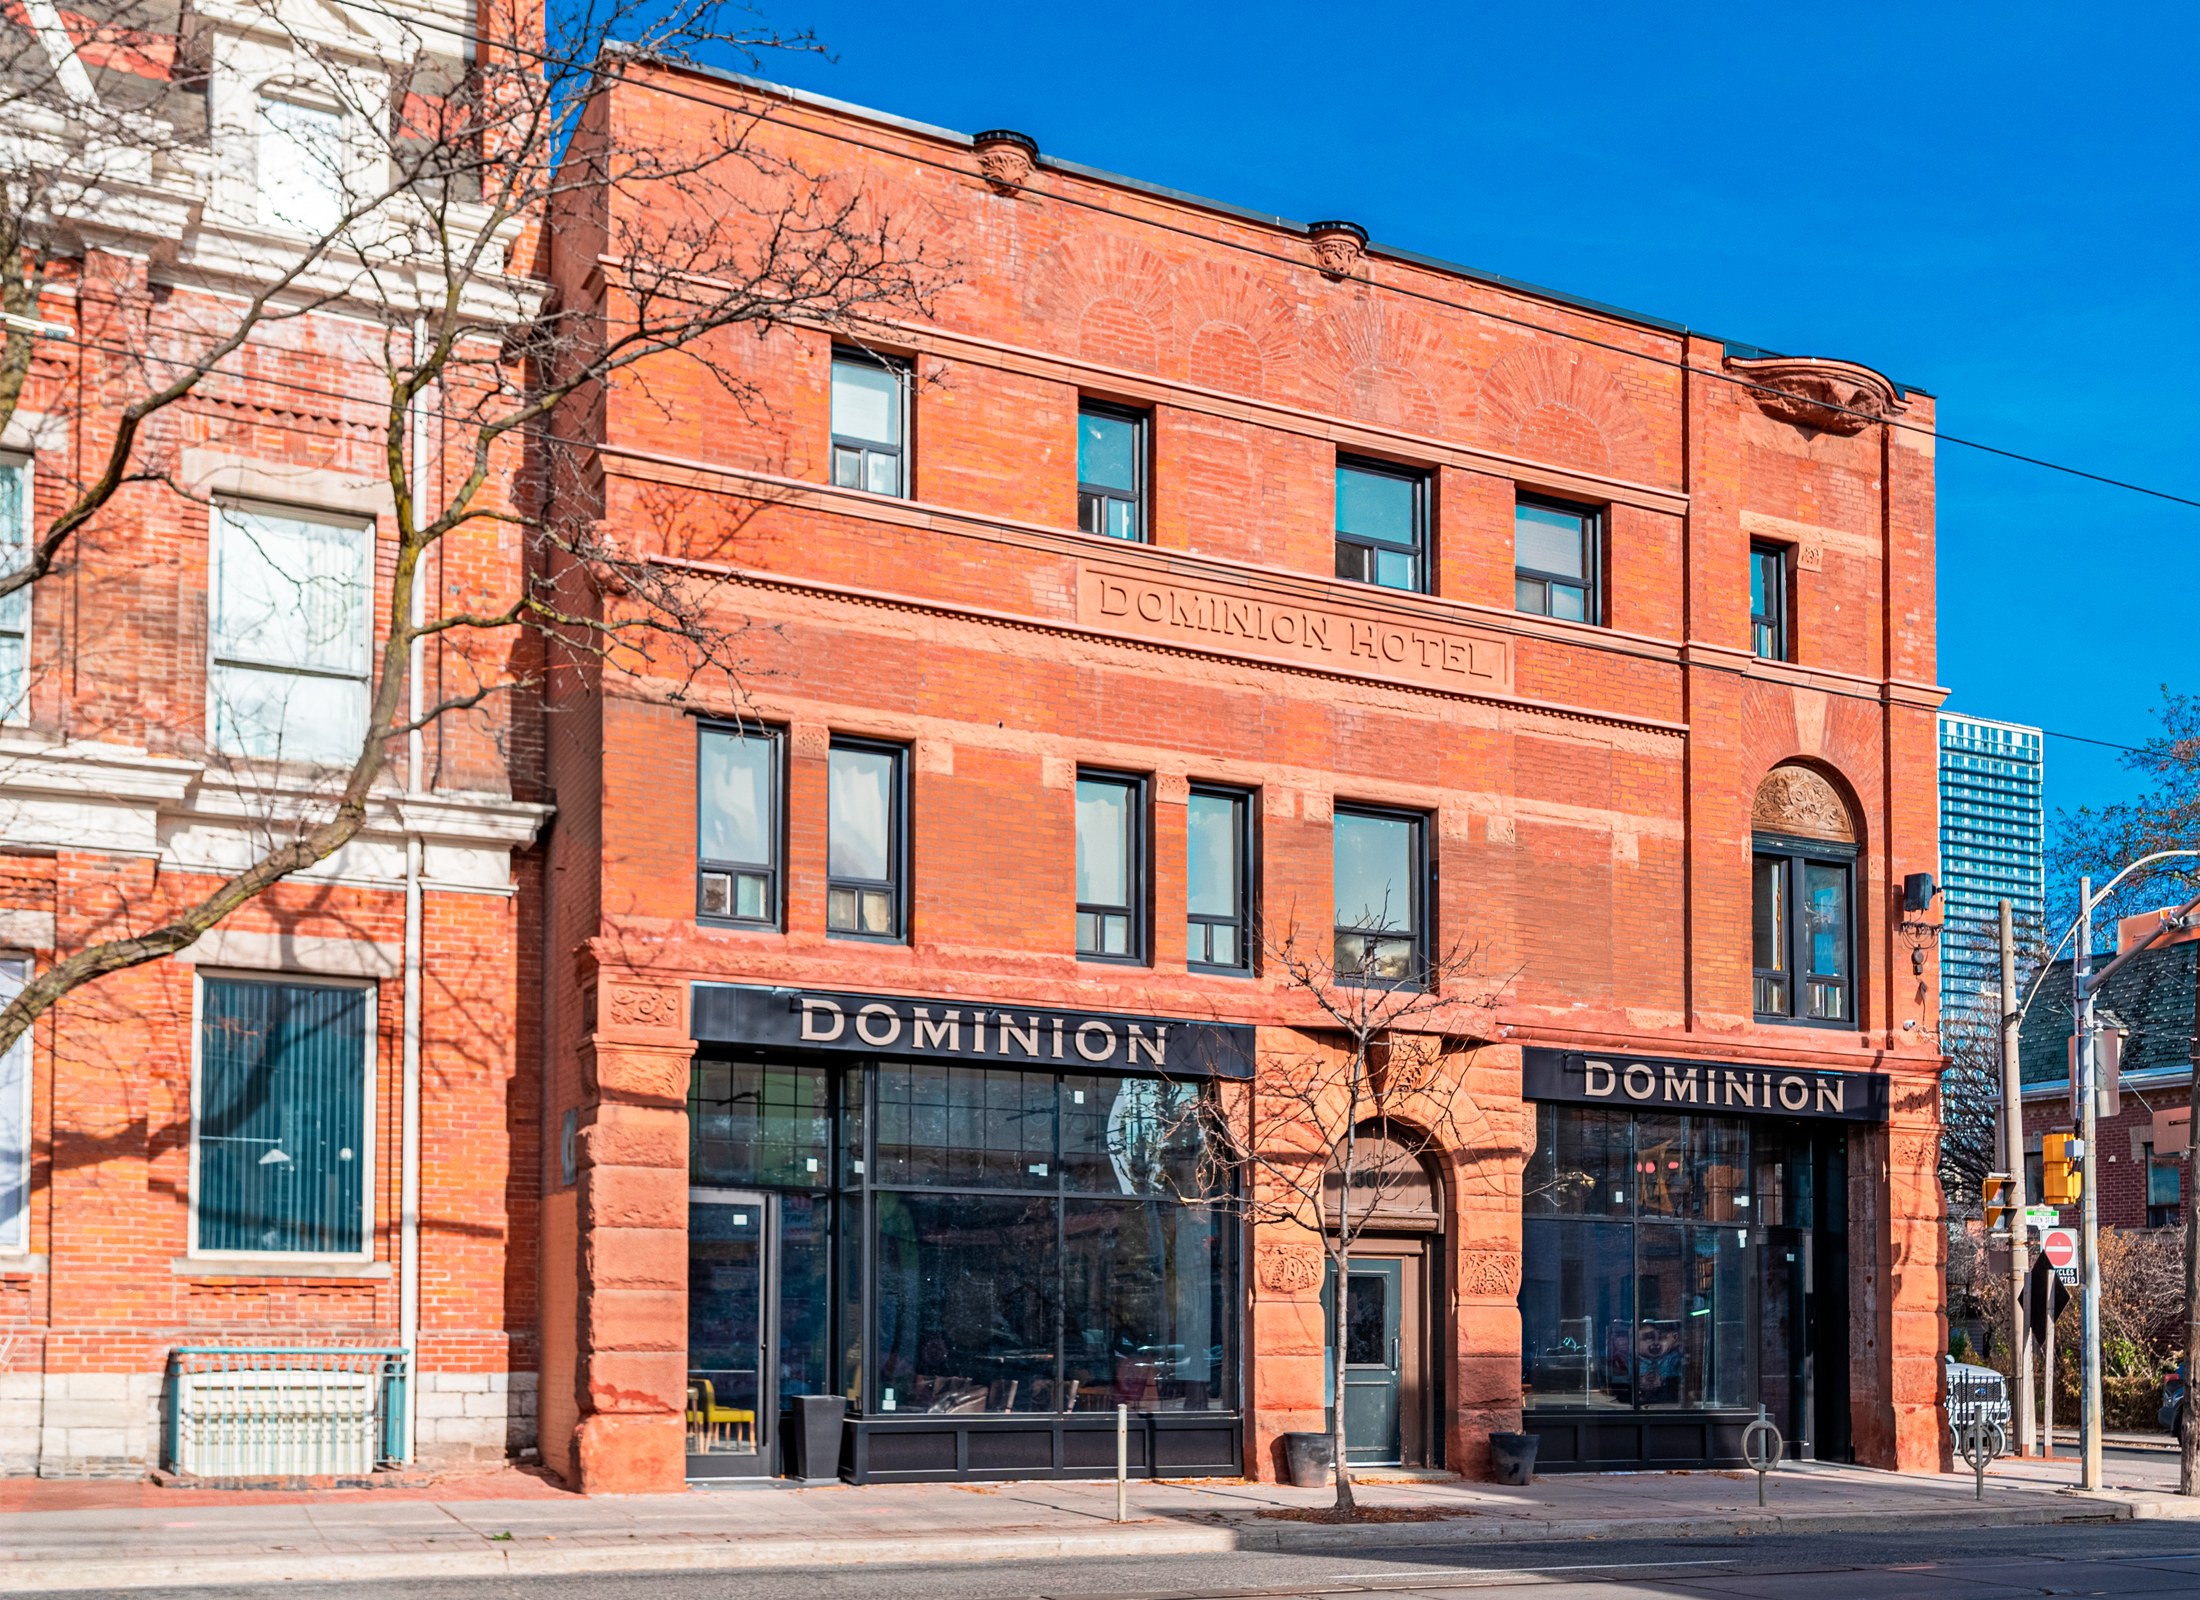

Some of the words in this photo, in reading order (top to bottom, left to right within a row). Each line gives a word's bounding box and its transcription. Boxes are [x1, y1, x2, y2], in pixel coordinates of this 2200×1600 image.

[1100, 579, 1332, 651] DOMINION
[1350, 621, 1493, 679] HOTEL
[799, 998, 1167, 1066] DOMINION
[1584, 1060, 1845, 1113] DOMINION
[2030, 1216, 2043, 1224] QUEEN
